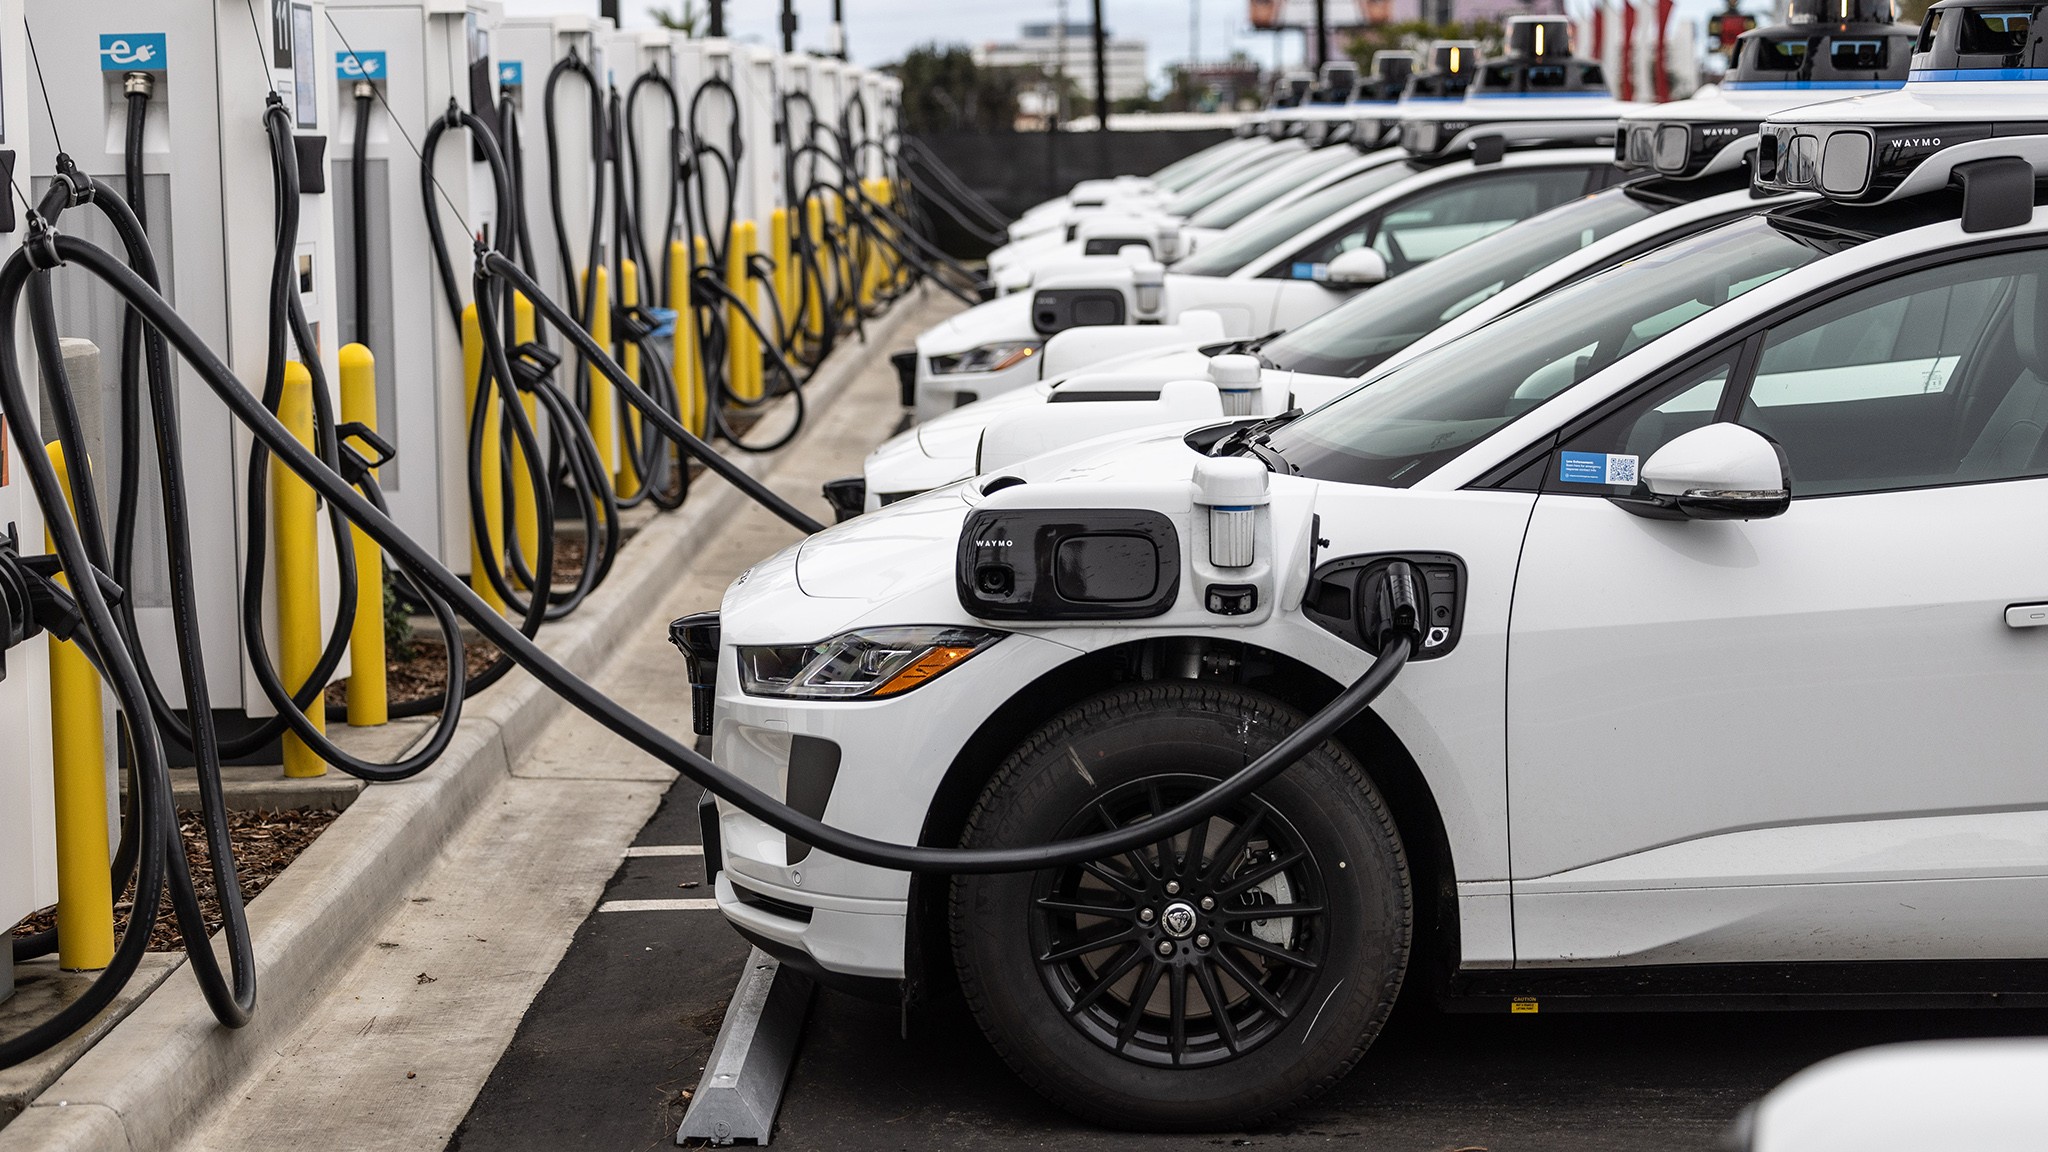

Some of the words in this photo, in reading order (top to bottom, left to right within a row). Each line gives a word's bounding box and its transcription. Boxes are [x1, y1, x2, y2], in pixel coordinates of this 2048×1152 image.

[275, 0, 289, 51] 11
[1702, 127, 1739, 136] WAYMO
[1891, 137, 1942, 148] WAYMO
